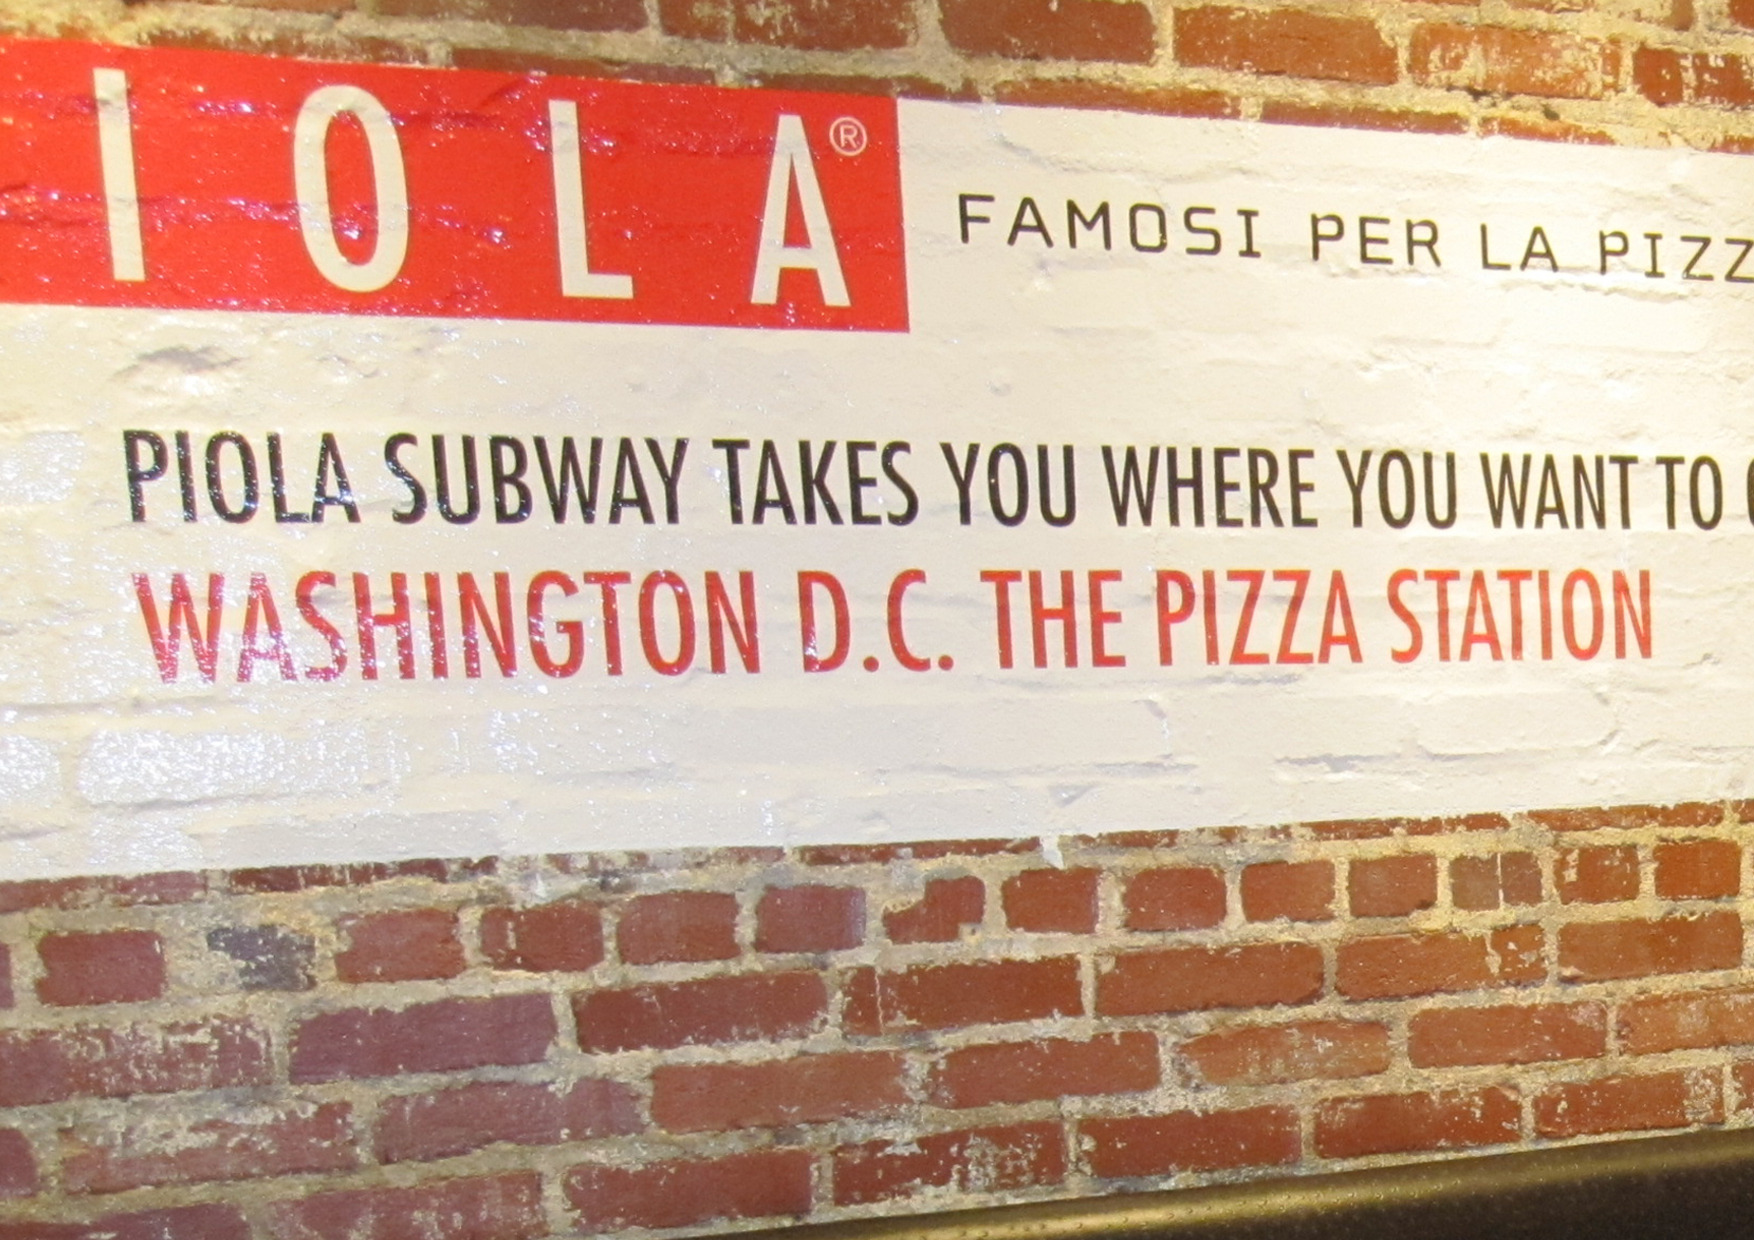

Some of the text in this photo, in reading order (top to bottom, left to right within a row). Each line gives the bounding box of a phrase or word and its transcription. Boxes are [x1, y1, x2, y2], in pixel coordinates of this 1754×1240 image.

[957, 192, 1263, 260] FAMOSI
[1310, 211, 1442, 268] PER
[1480, 223, 1560, 274] LA
[121, 429, 362, 524] PIOLA
[383, 433, 690, 526] SUBWAY
[712, 436, 920, 527] TAKES
[939, 441, 1078, 529] YOU
[1102, 445, 1318, 529] WHERE
[1336, 449, 1458, 530] YOU
[1479, 453, 1641, 531] WANT
[1655, 455, 1724, 532] TO
[131, 567, 1653, 685] WASHINGTON D.C. THE PIZZA STATION
